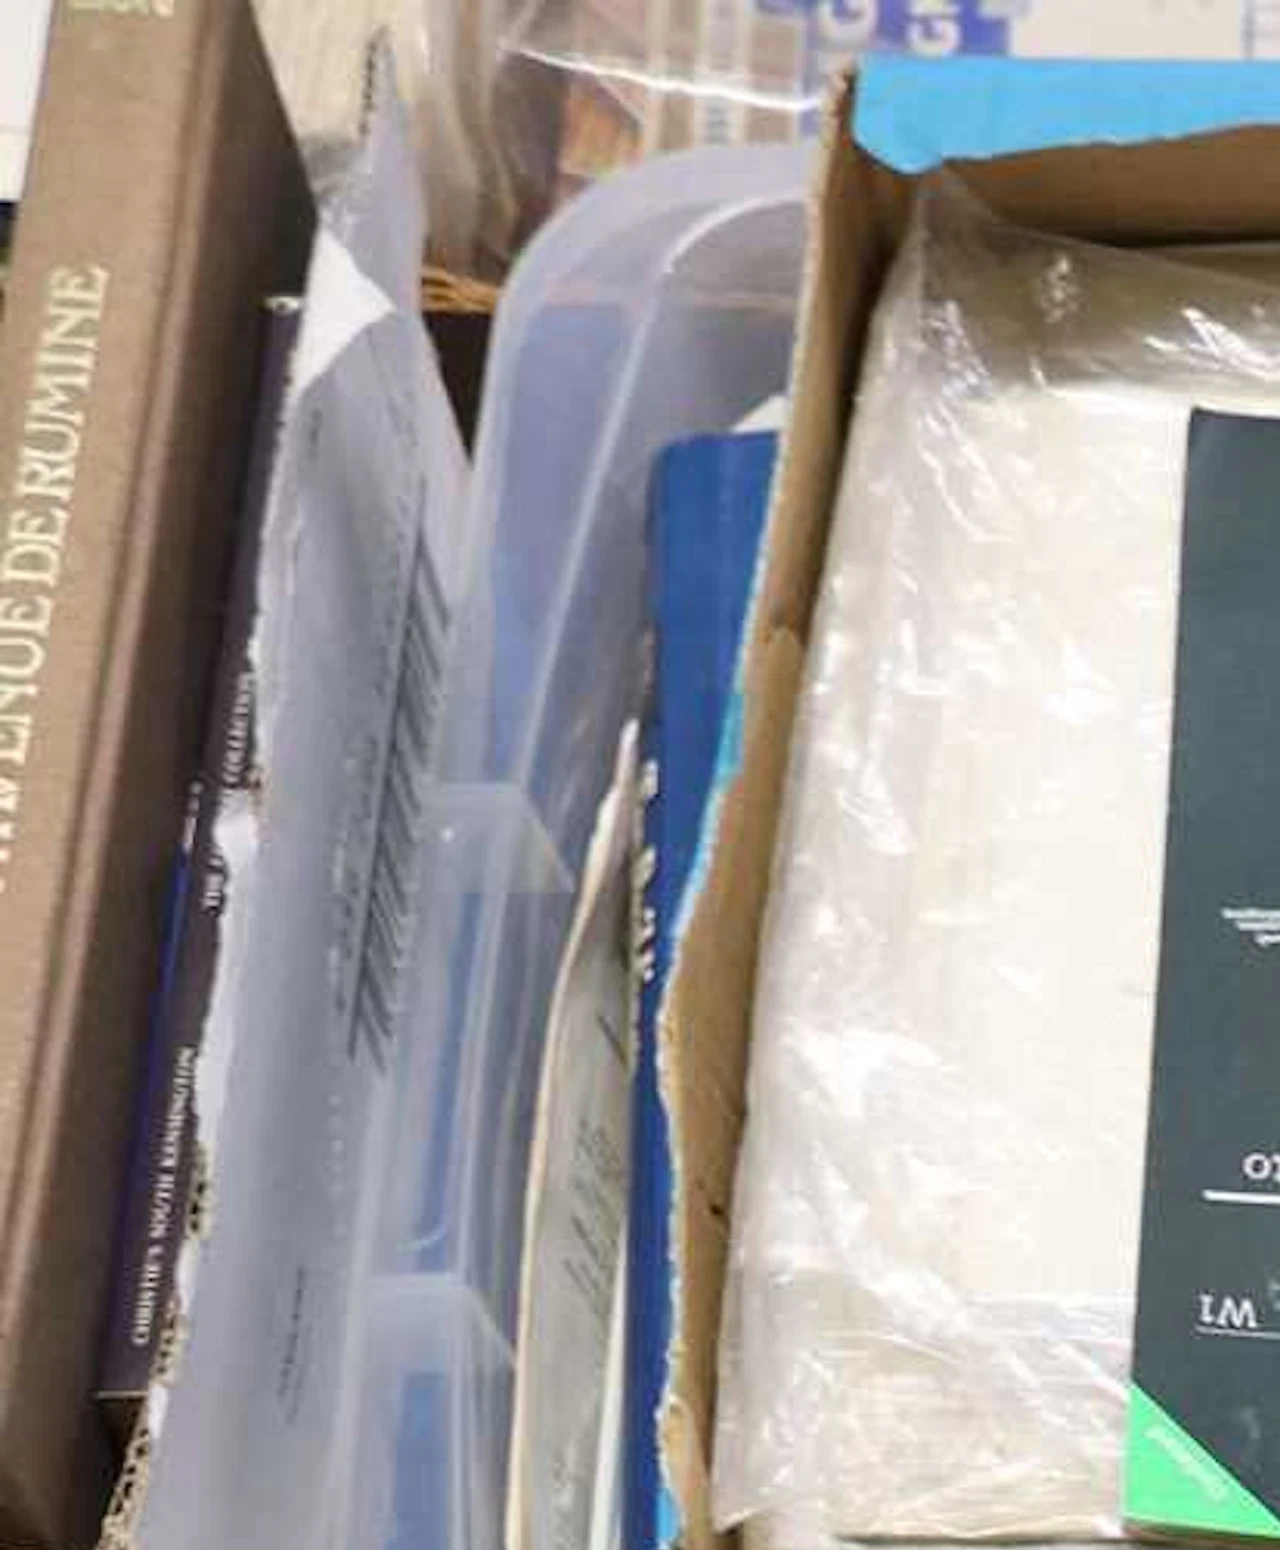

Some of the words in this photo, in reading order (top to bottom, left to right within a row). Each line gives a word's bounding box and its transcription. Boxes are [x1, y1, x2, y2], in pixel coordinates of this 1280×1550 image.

[24, 264, 109, 503] RUMINE
[8, 505, 68, 606] DE
[1199, 1294, 1258, 1330] W1
